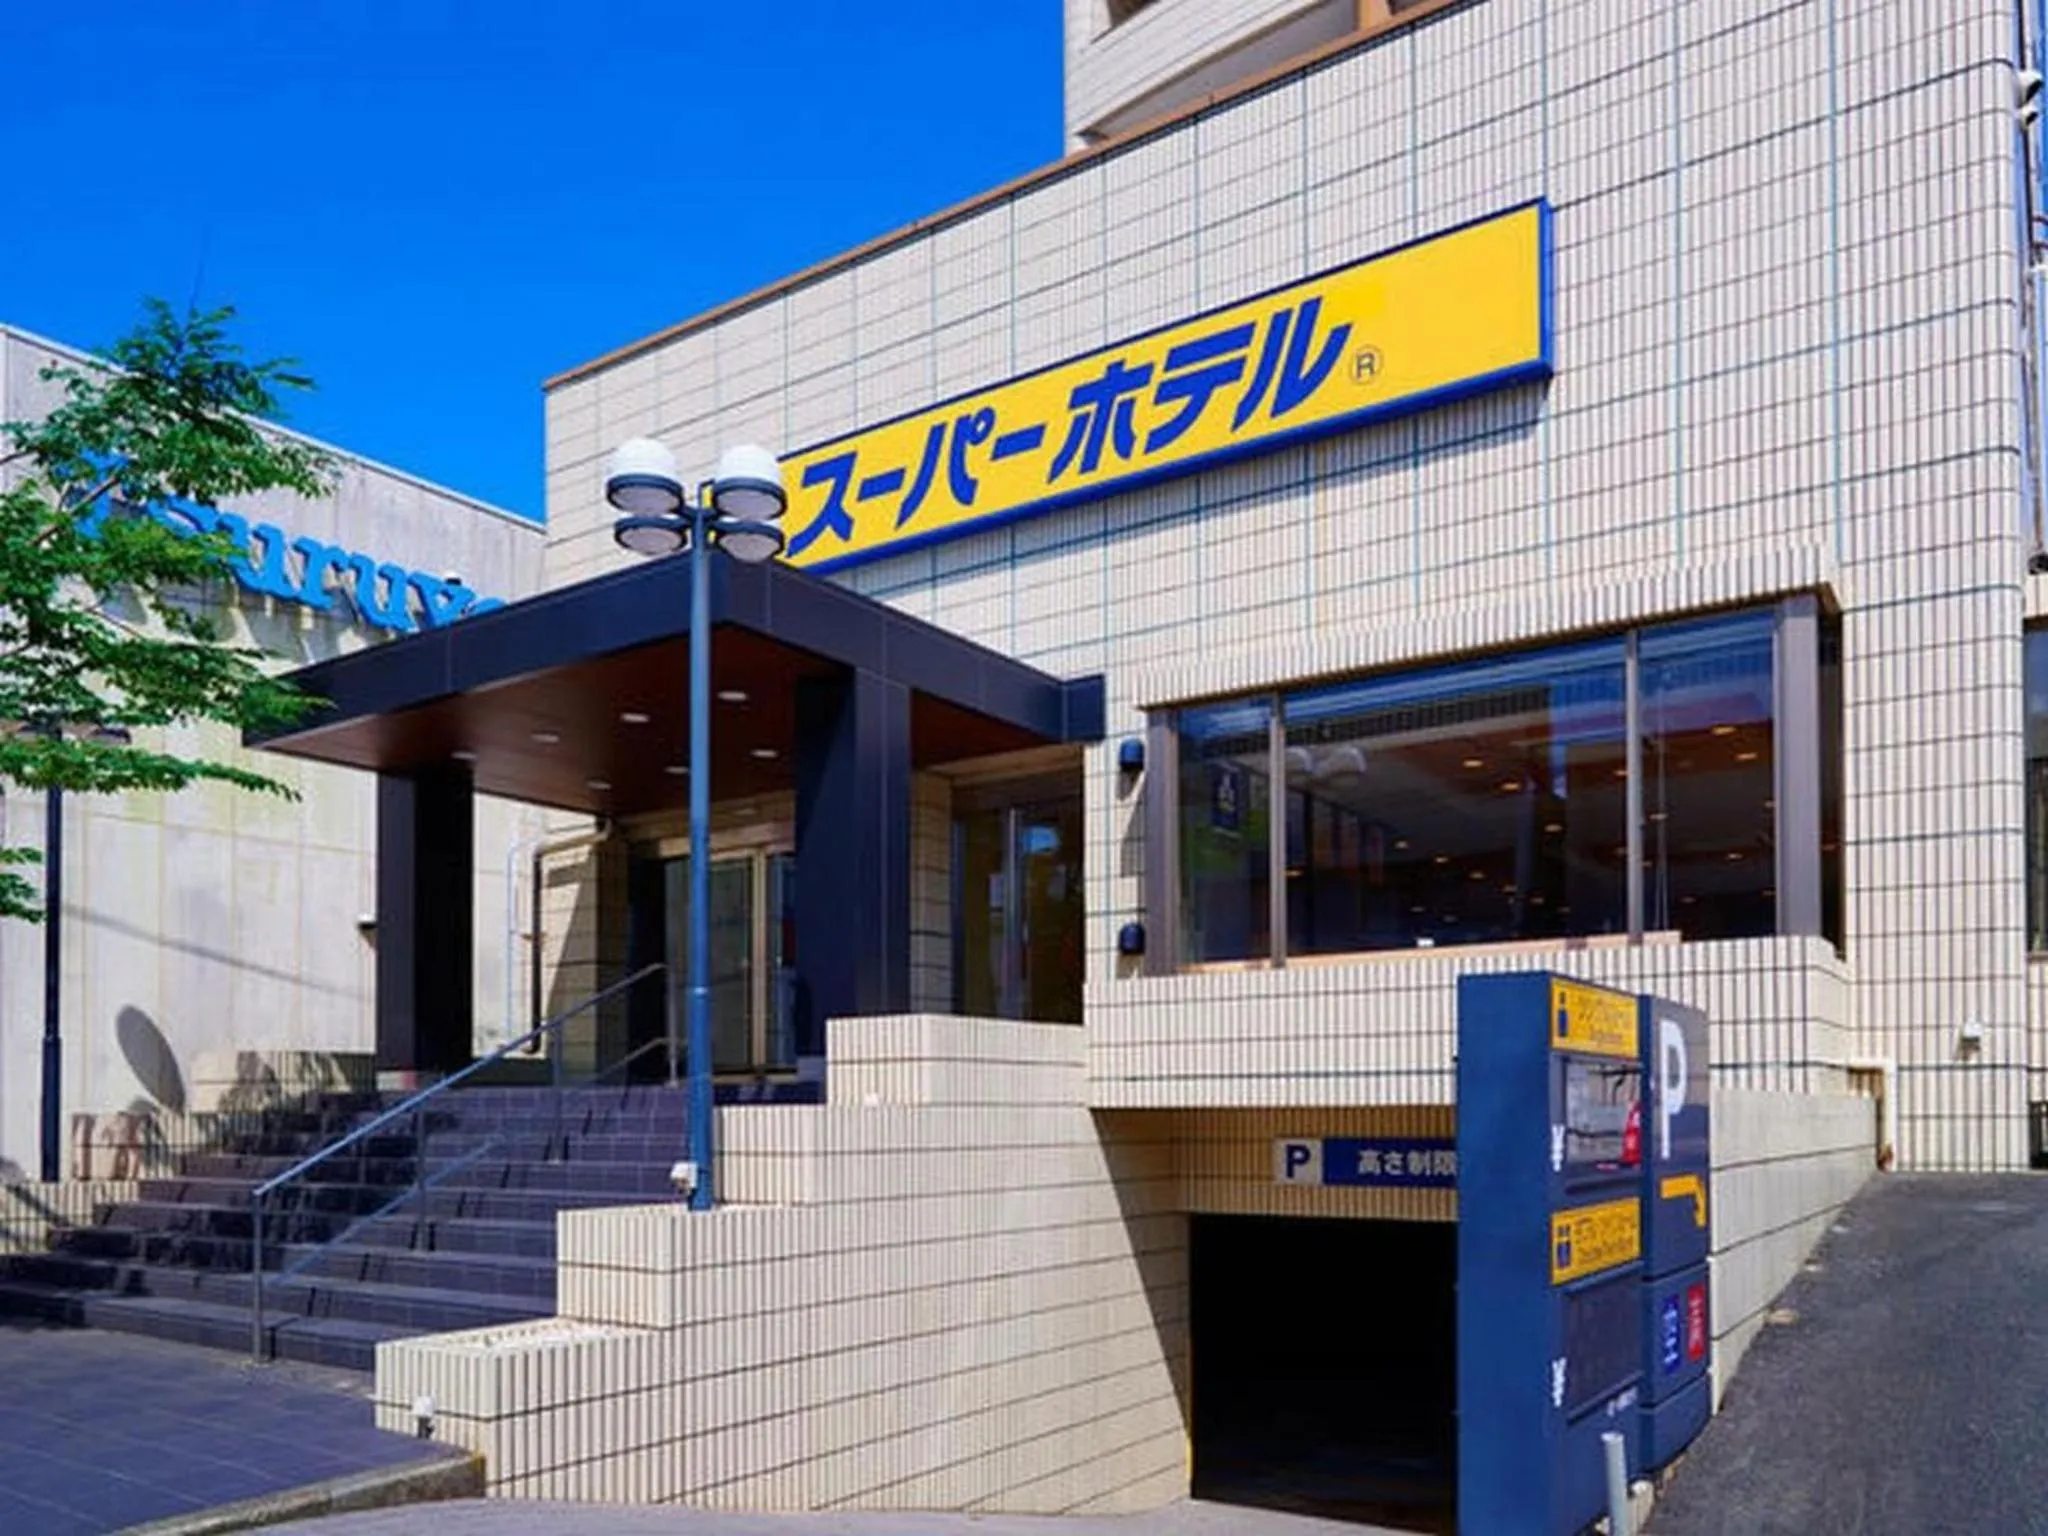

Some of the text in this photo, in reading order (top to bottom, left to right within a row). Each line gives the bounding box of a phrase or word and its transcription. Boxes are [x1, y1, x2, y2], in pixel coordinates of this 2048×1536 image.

[785, 295, 1353, 558] スーパーホテル
[1660, 1018, 1688, 1160] P
[1285, 1144, 1311, 1179] P
